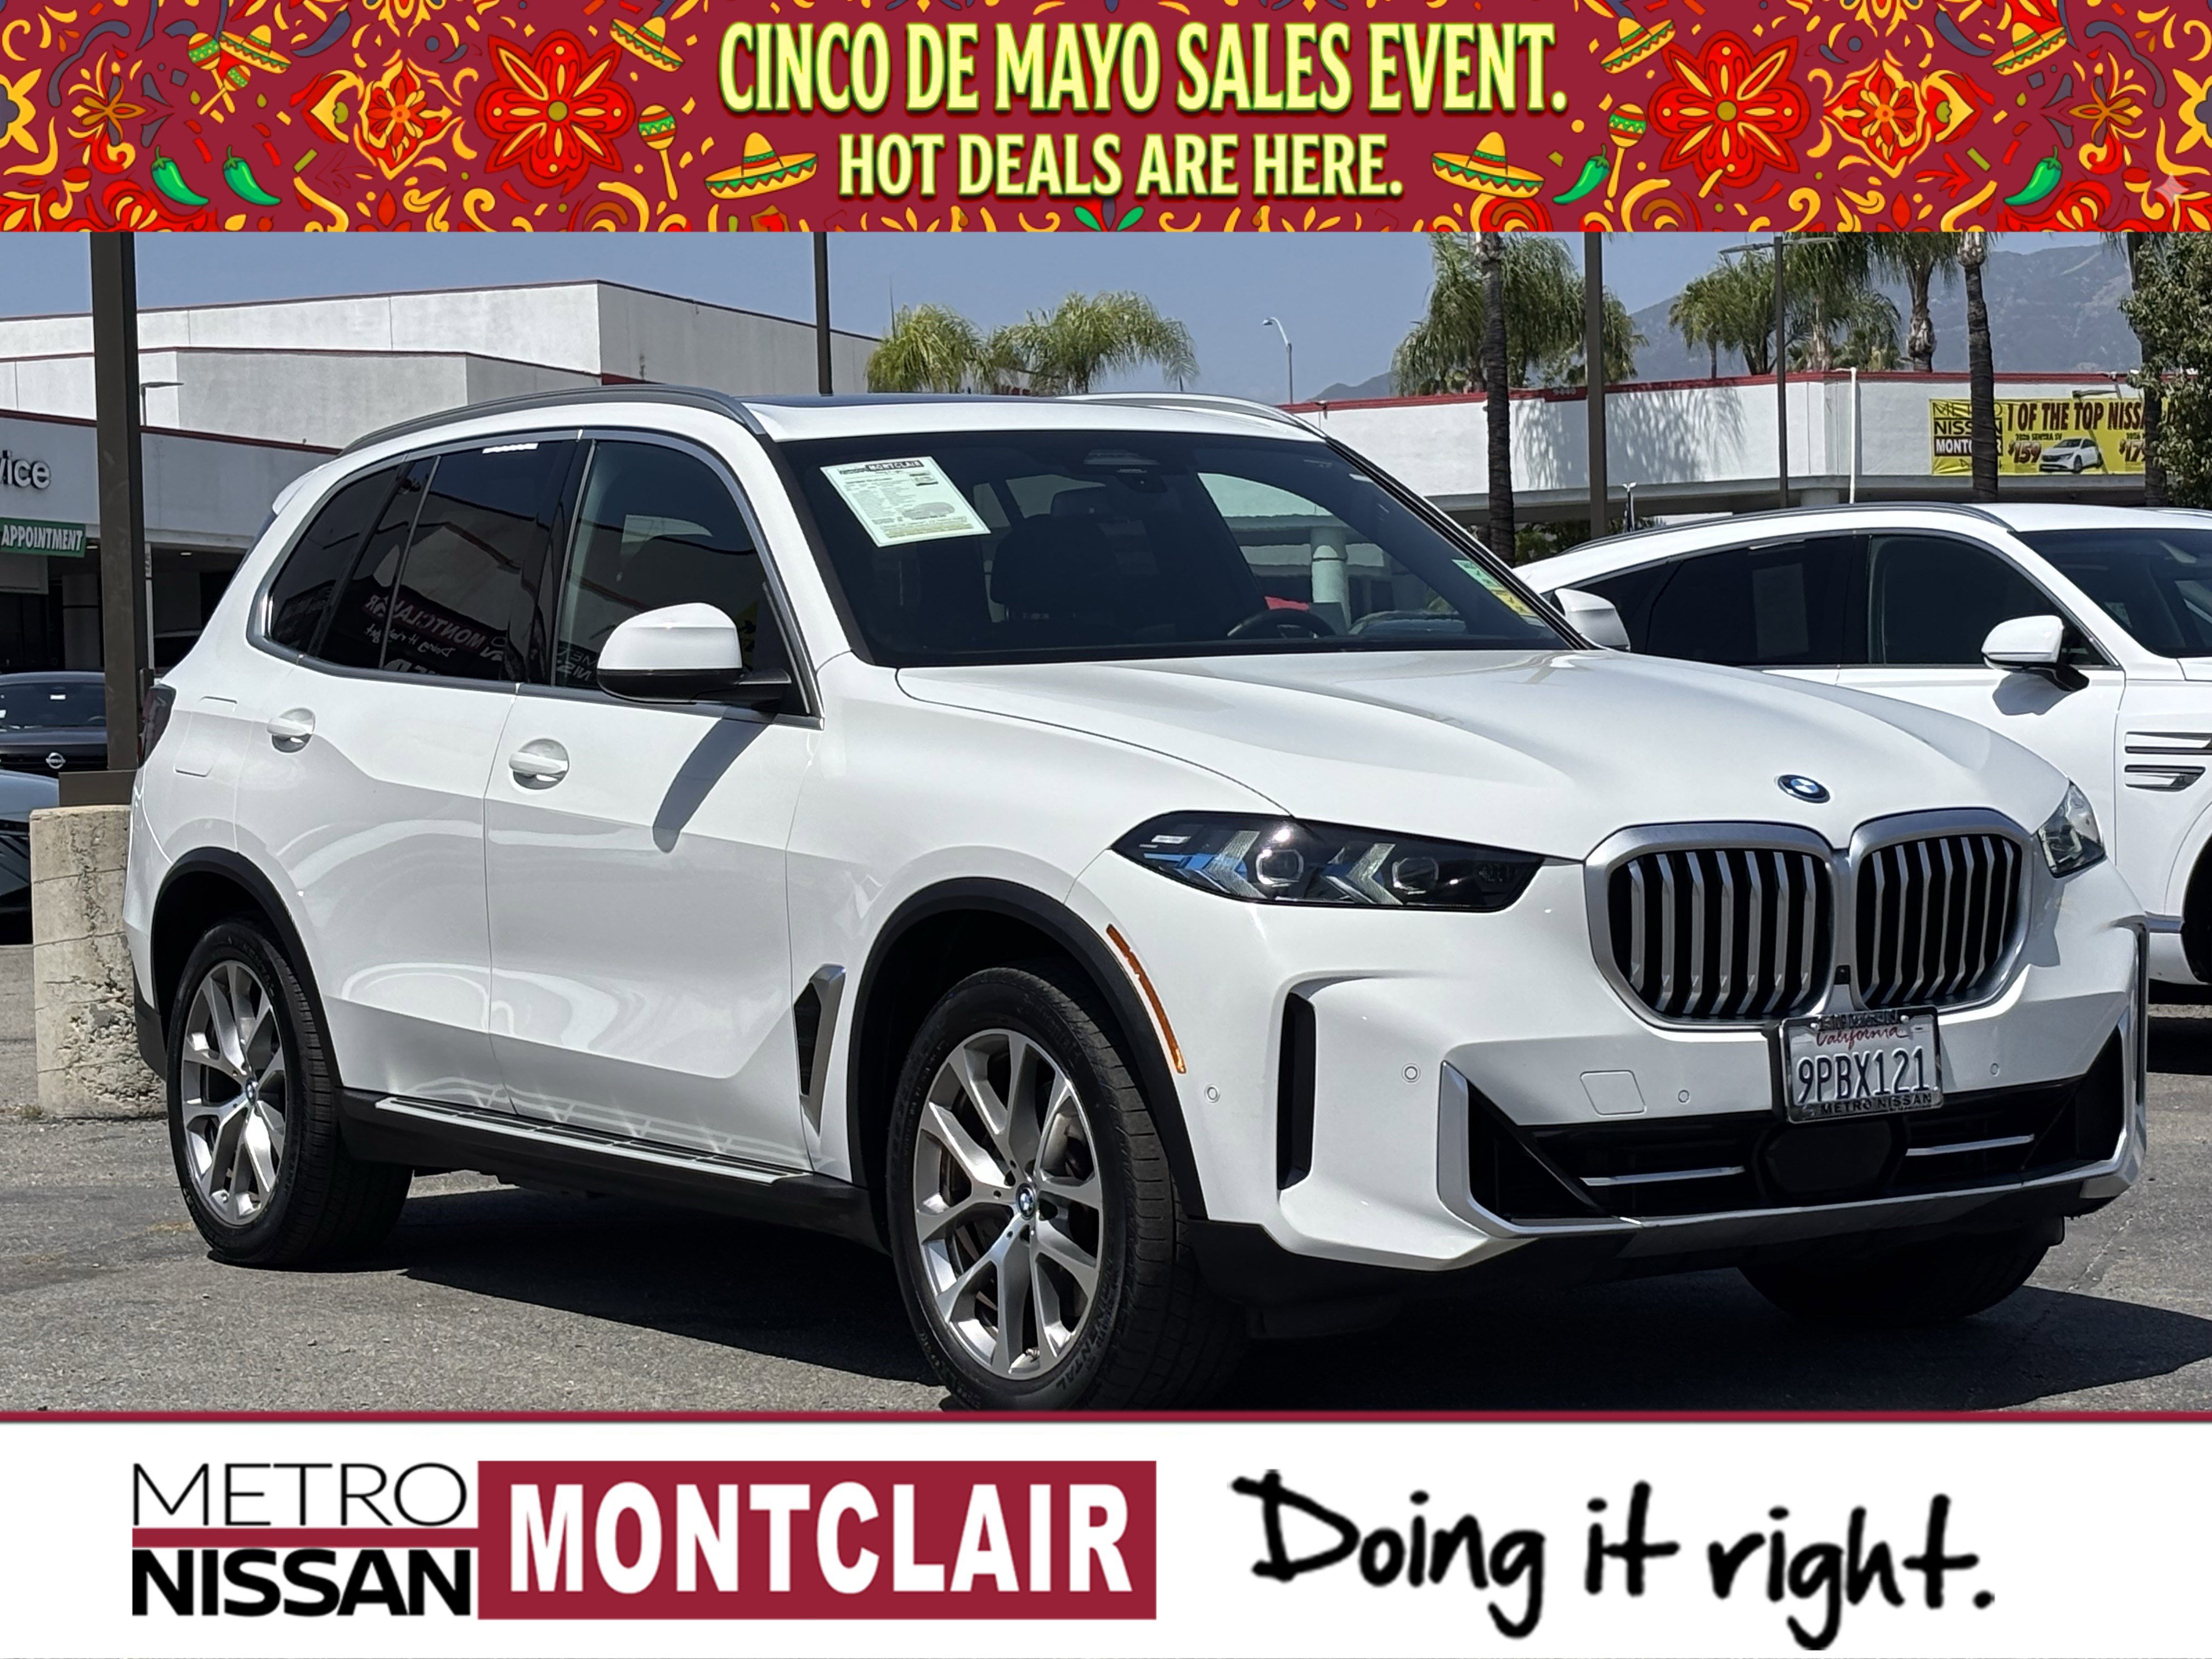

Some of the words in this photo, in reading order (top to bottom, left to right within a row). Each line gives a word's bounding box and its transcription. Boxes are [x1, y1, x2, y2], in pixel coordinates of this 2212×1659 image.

[1934, 421, 2002, 435] NISSN
[2018, 402, 2037, 431] OF
[2042, 402, 2070, 431] THE
[2074, 402, 2104, 430] TOP
[2108, 402, 2145, 430] NISS
[2008, 441, 2041, 464] $159
[1, 524, 83, 551] APPOINTMENT
[1816, 1025, 1910, 1050] California
[1796, 1046, 1931, 1105] 9PBX121
[1820, 1098, 1872, 1115] METRO
[1877, 1092, 1932, 1108] NISSAN
